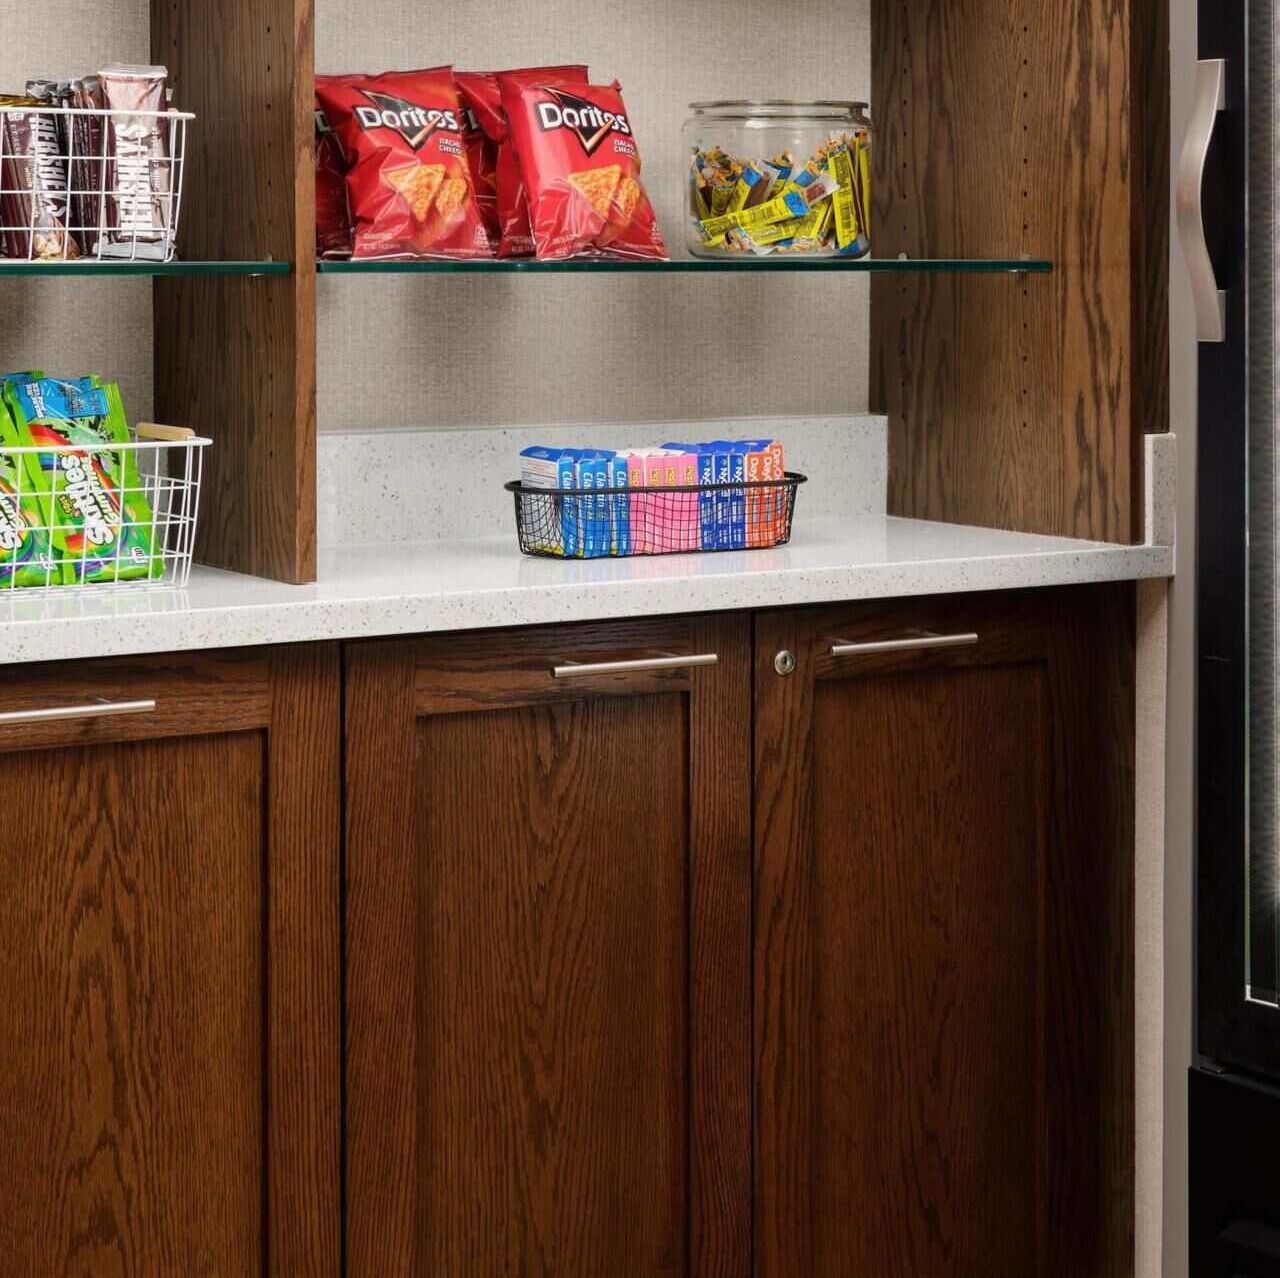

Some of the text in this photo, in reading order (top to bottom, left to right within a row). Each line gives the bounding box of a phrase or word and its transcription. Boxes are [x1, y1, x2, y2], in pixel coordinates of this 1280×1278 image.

[355, 106, 459, 130] Doritos
[538, 102, 632, 134] Doritos
[151, 170, 161, 189] milk
[60, 454, 115, 546] Skittles
